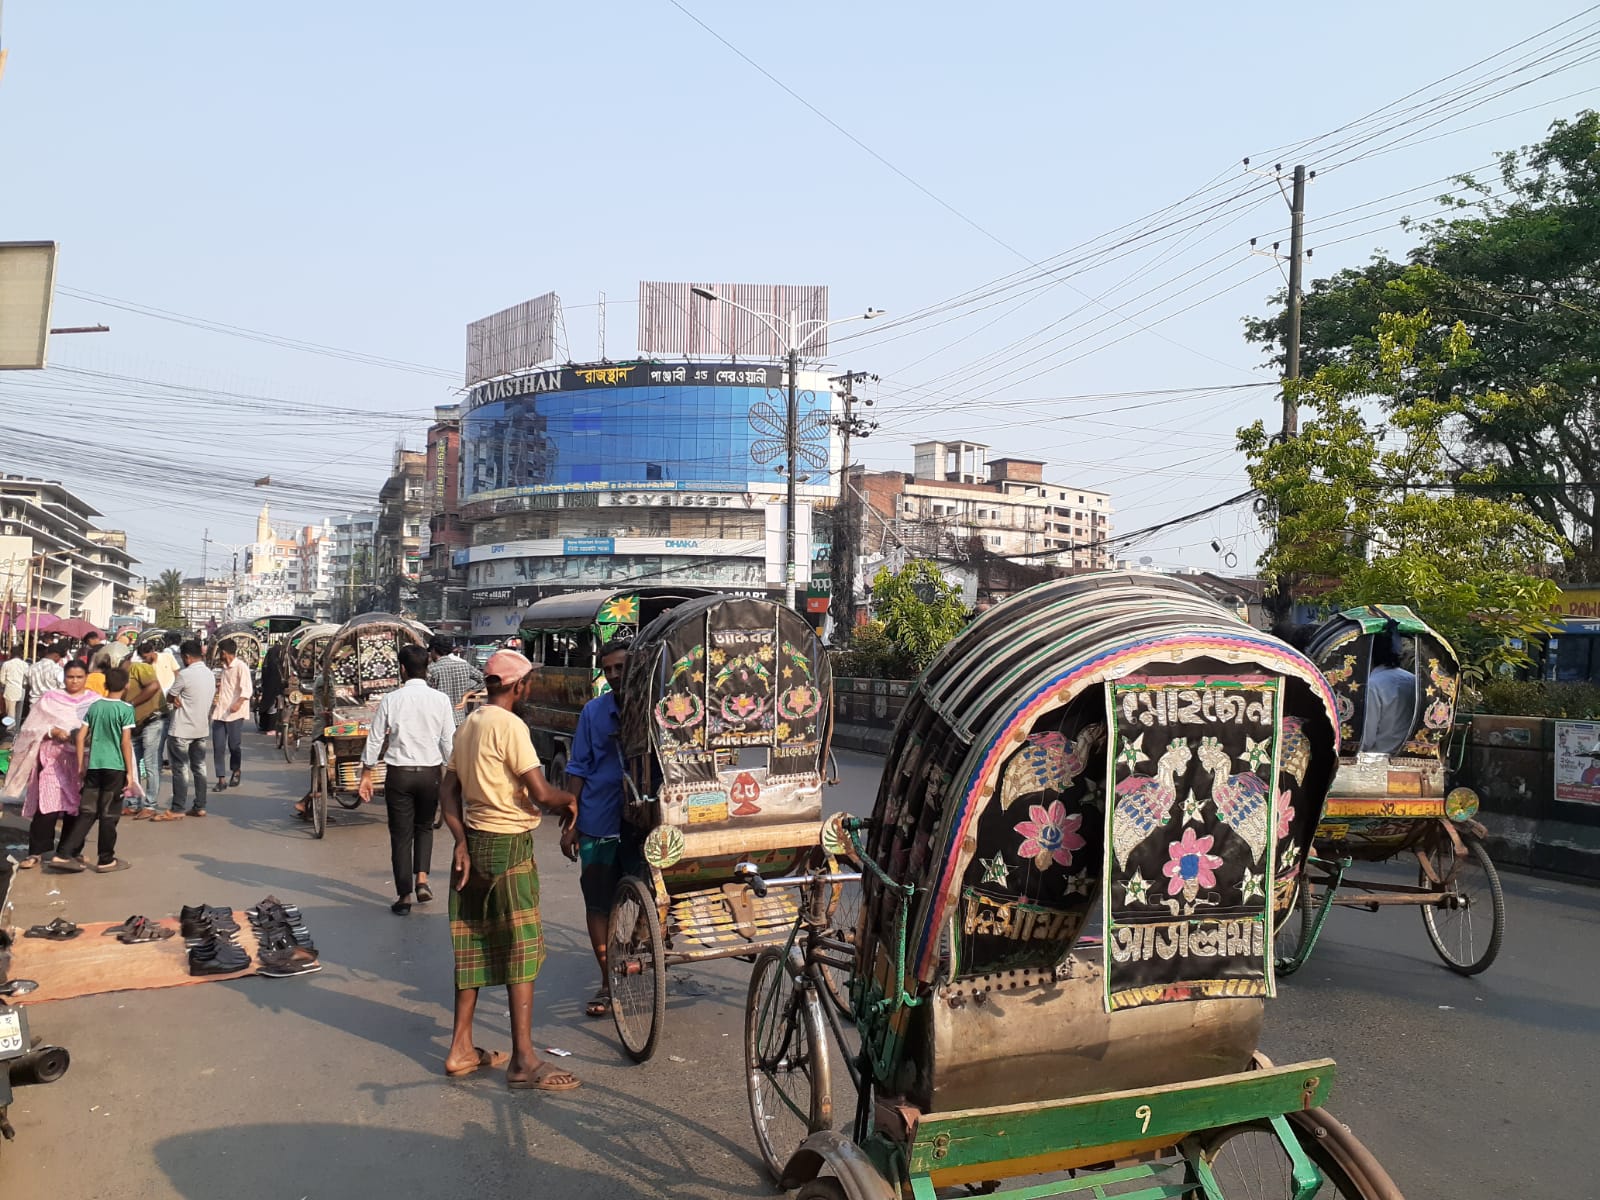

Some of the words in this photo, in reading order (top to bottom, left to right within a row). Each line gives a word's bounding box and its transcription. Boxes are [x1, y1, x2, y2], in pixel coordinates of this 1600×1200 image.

[576, 366, 635, 385] রাজস্থান
[651, 366, 686, 383] পাঞ্জাবী
[716, 368, 767, 384] শেরওয়ানী
[476, 371, 562, 407] RAJASTHAN
[665, 540, 698, 548] DHAKA
[811, 578, 832, 592] opp
